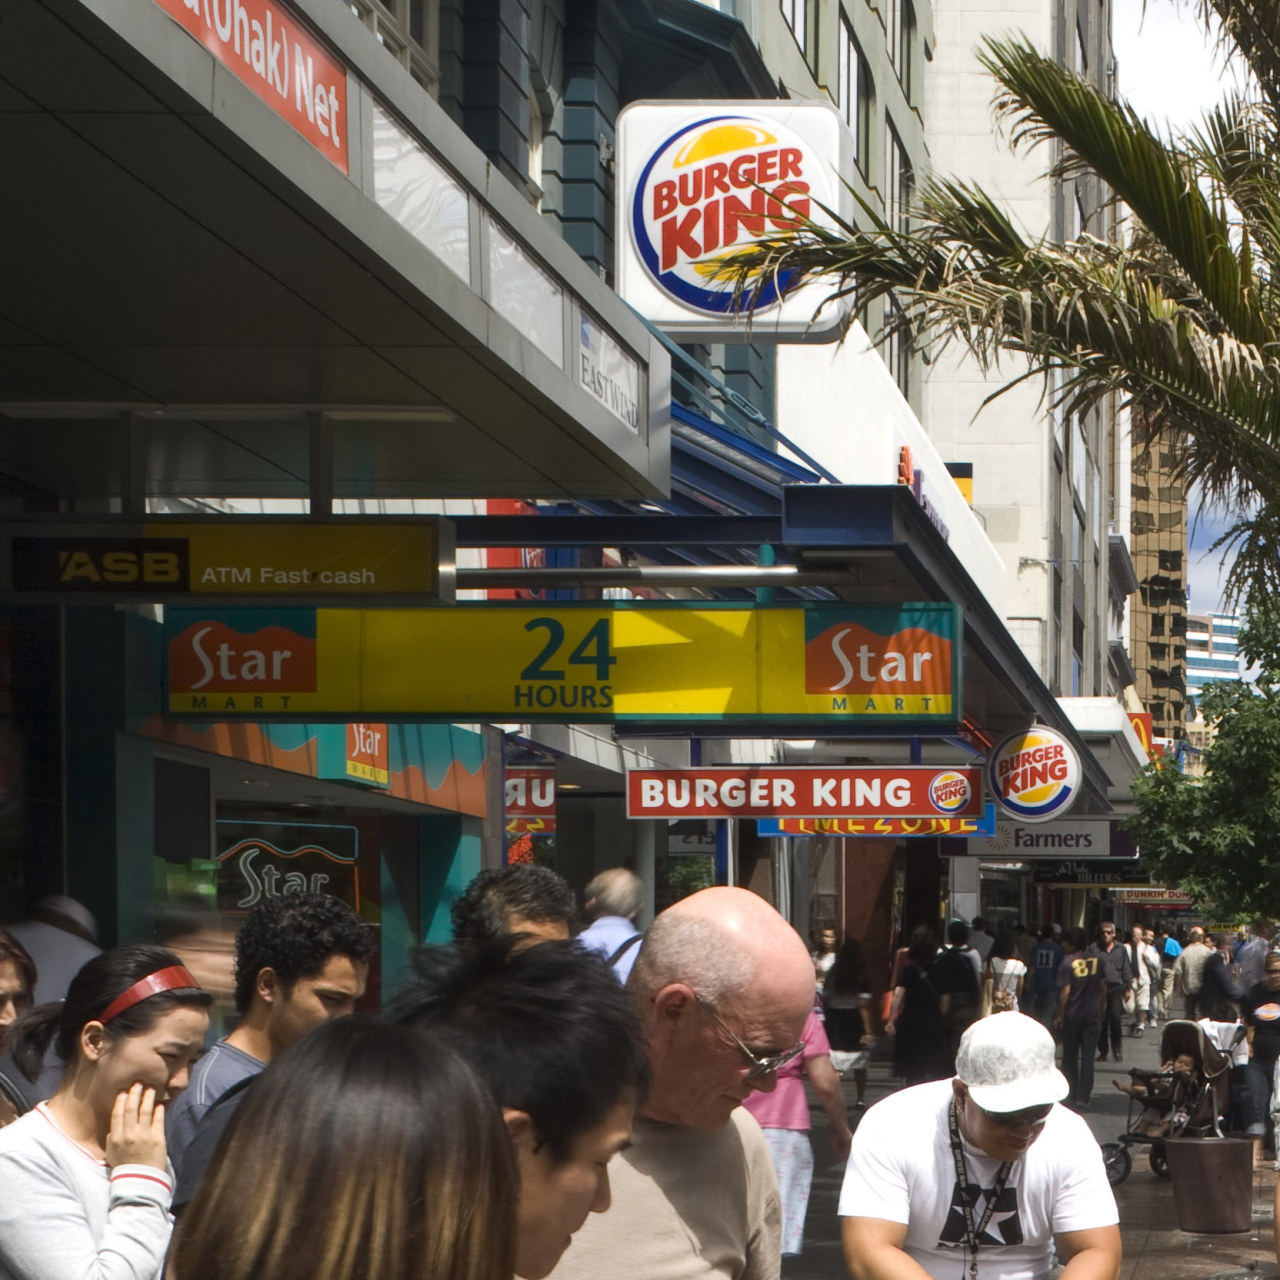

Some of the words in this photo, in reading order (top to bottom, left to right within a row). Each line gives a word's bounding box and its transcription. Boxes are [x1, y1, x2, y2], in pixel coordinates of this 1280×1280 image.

[294, 42, 341, 149] Net
[653, 147, 804, 221] BURGER
[661, 180, 811, 272] KING
[202, 568, 252, 584] ATM
[260, 566, 310, 584] Fast
[320, 566, 376, 585] cash
[191, 627, 292, 690] Star
[520, 617, 617, 681] 24
[829, 628, 933, 691] Star
[514, 685, 613, 708] HOURS
[1000, 744, 1064, 777] BURGER
[641, 778, 796, 808] BURGER
[812, 778, 911, 808] KING
[933, 778, 965, 795] BURGER
[935, 786, 967, 804] KING
[1002, 759, 1068, 799] KING
[1014, 827, 1093, 848] Farmers
[238, 848, 329, 908] Star
[1072, 957, 1099, 978] 87
